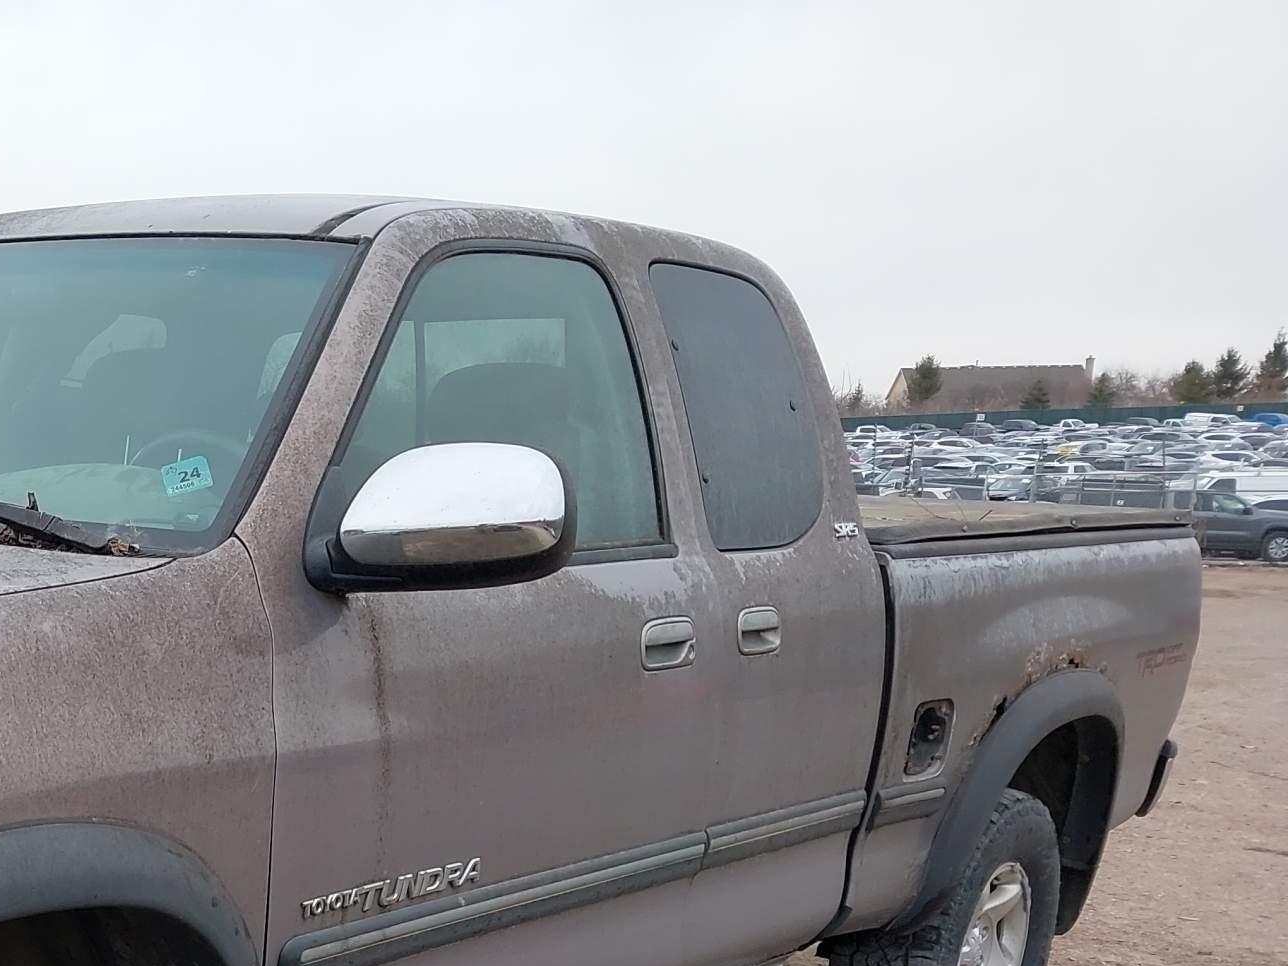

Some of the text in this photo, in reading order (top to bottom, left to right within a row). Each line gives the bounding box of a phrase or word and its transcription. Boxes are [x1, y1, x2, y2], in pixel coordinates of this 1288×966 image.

[178, 467, 201, 483] 24
[302, 857, 481, 918] TOYOTA TUNDRA
